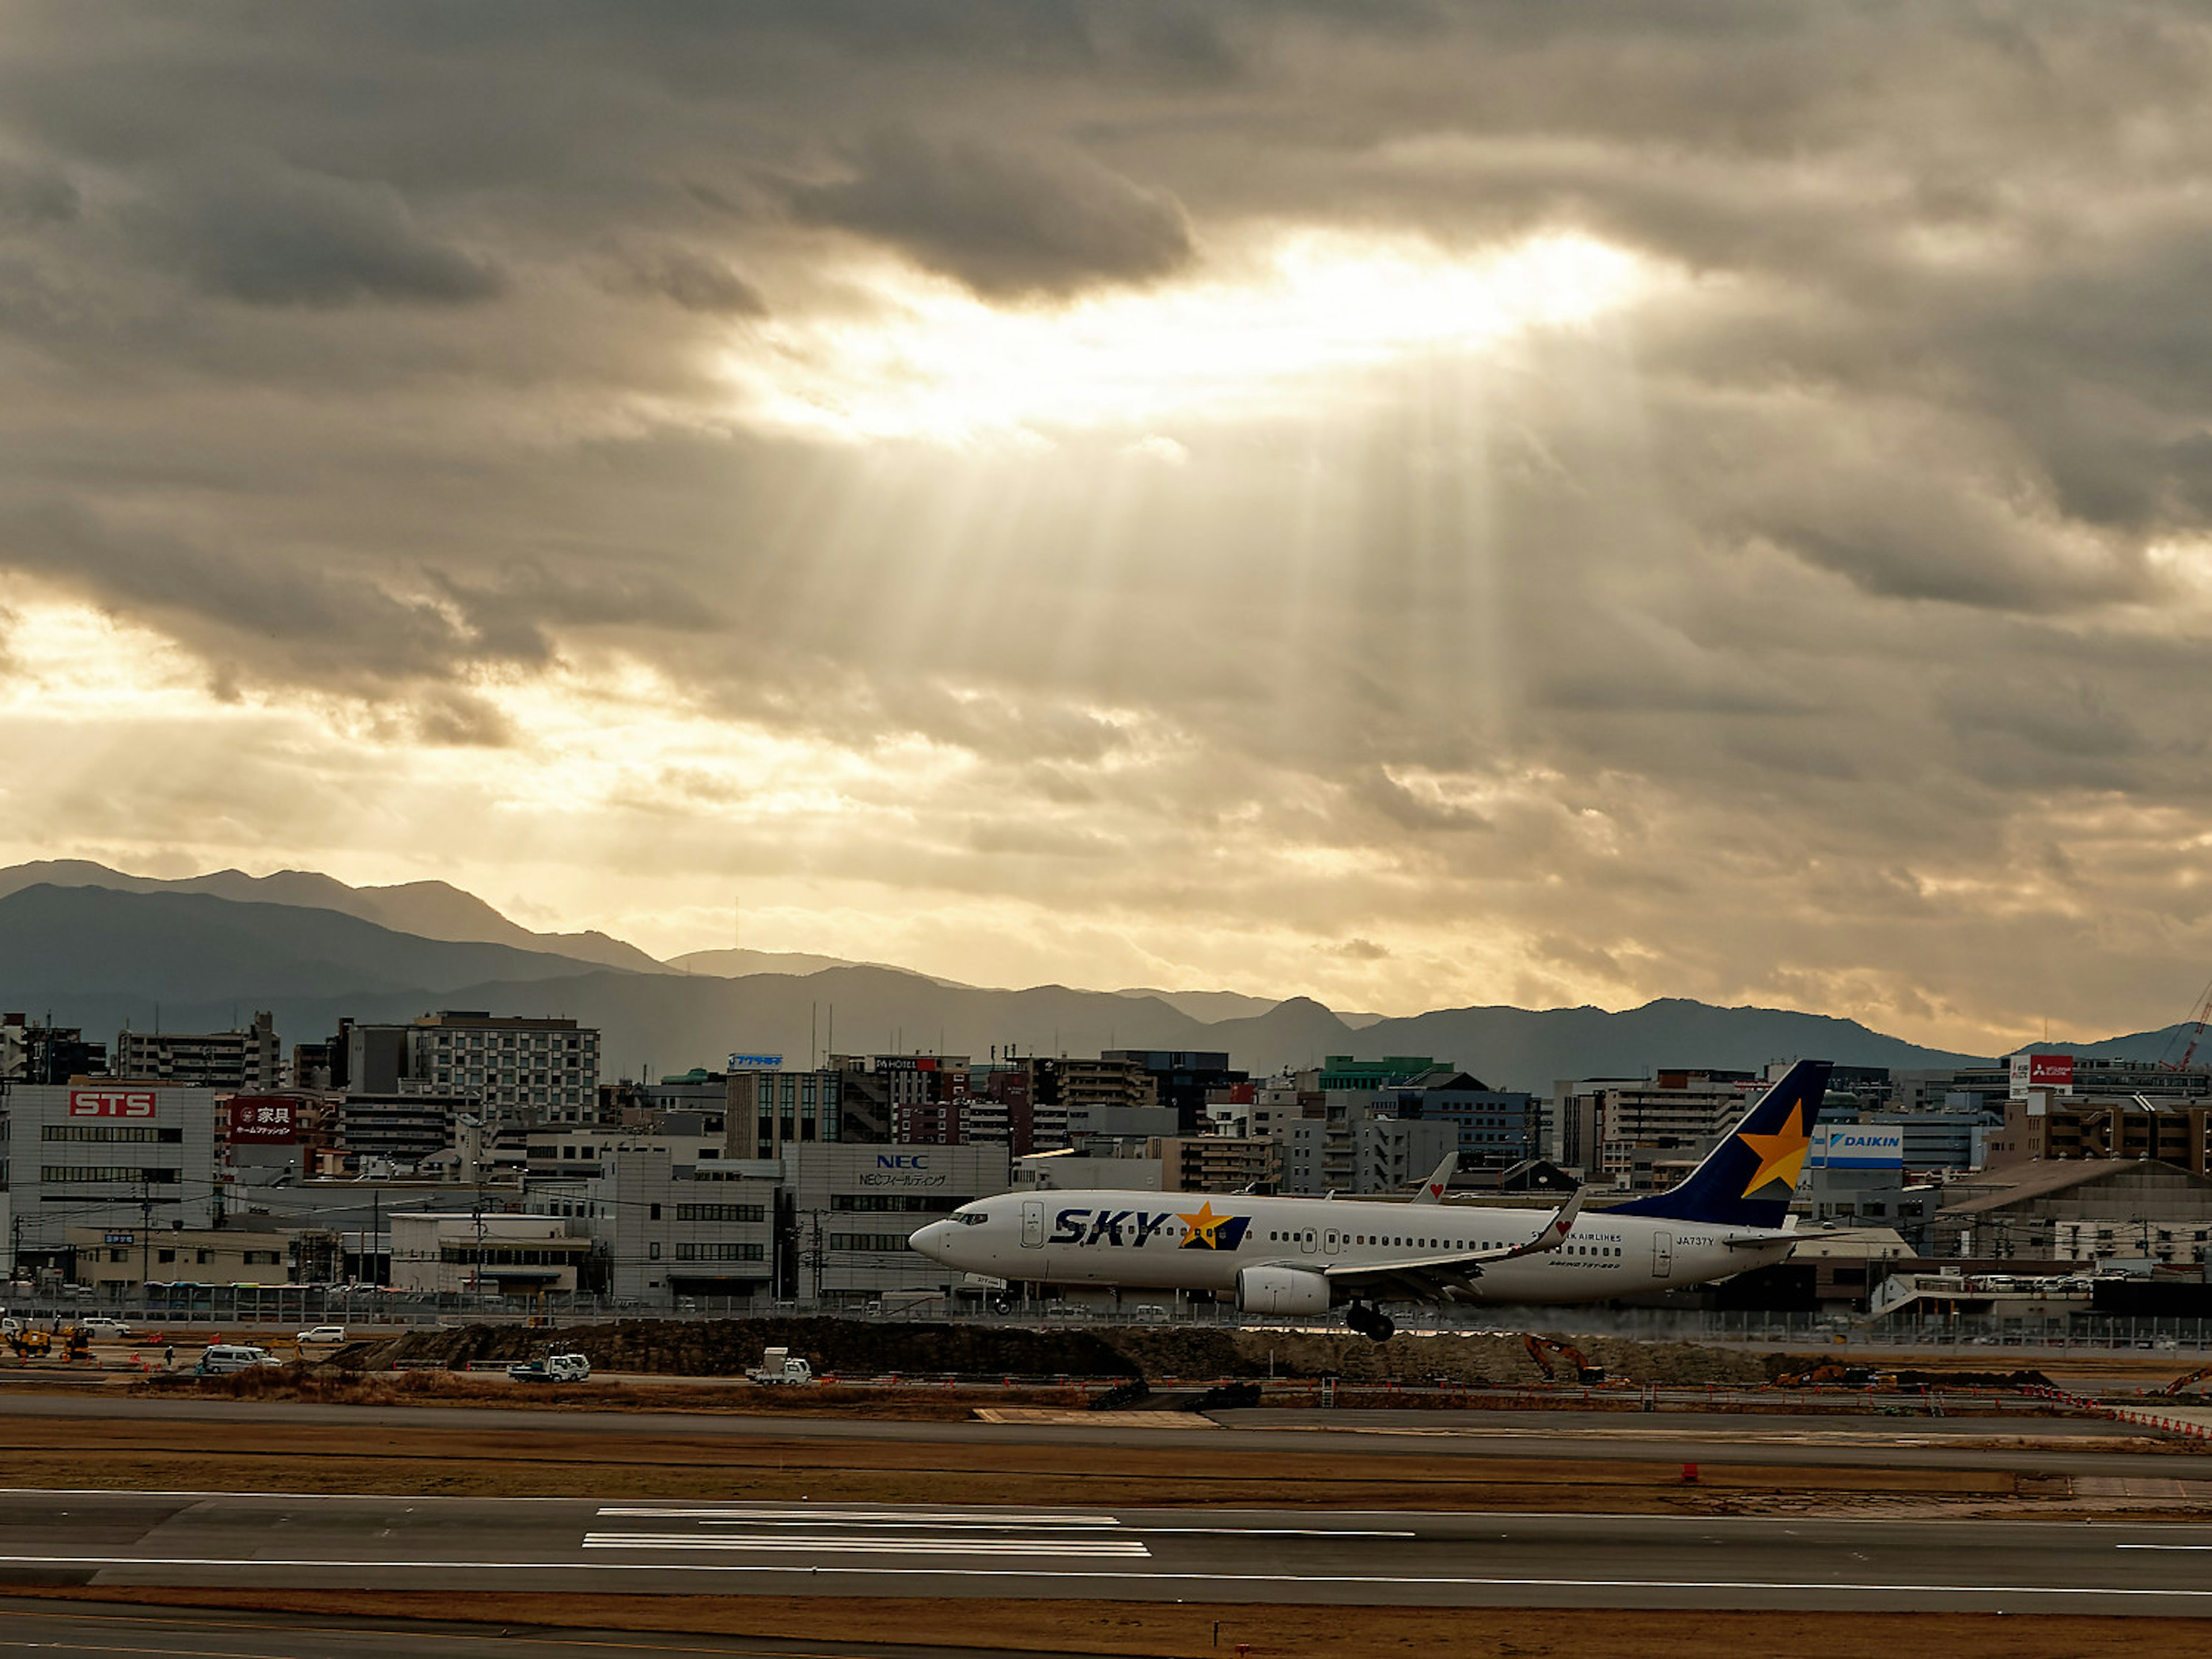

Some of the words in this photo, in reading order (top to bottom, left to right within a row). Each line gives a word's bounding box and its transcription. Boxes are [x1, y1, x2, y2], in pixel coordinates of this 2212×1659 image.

[888, 1059, 917, 1069] HOTEL
[75, 1093, 150, 1116] STS
[257, 1106, 291, 1123] 家具
[1844, 1137, 1899, 1146] DAIKIN
[877, 1155, 929, 1169] NEC
[859, 1173, 946, 1186] NECフィールディング
[1048, 1209, 1173, 1247] SKY
[1580, 1233, 1622, 1242] AIRLINES
[1677, 1237, 1714, 1245] JA737Y
